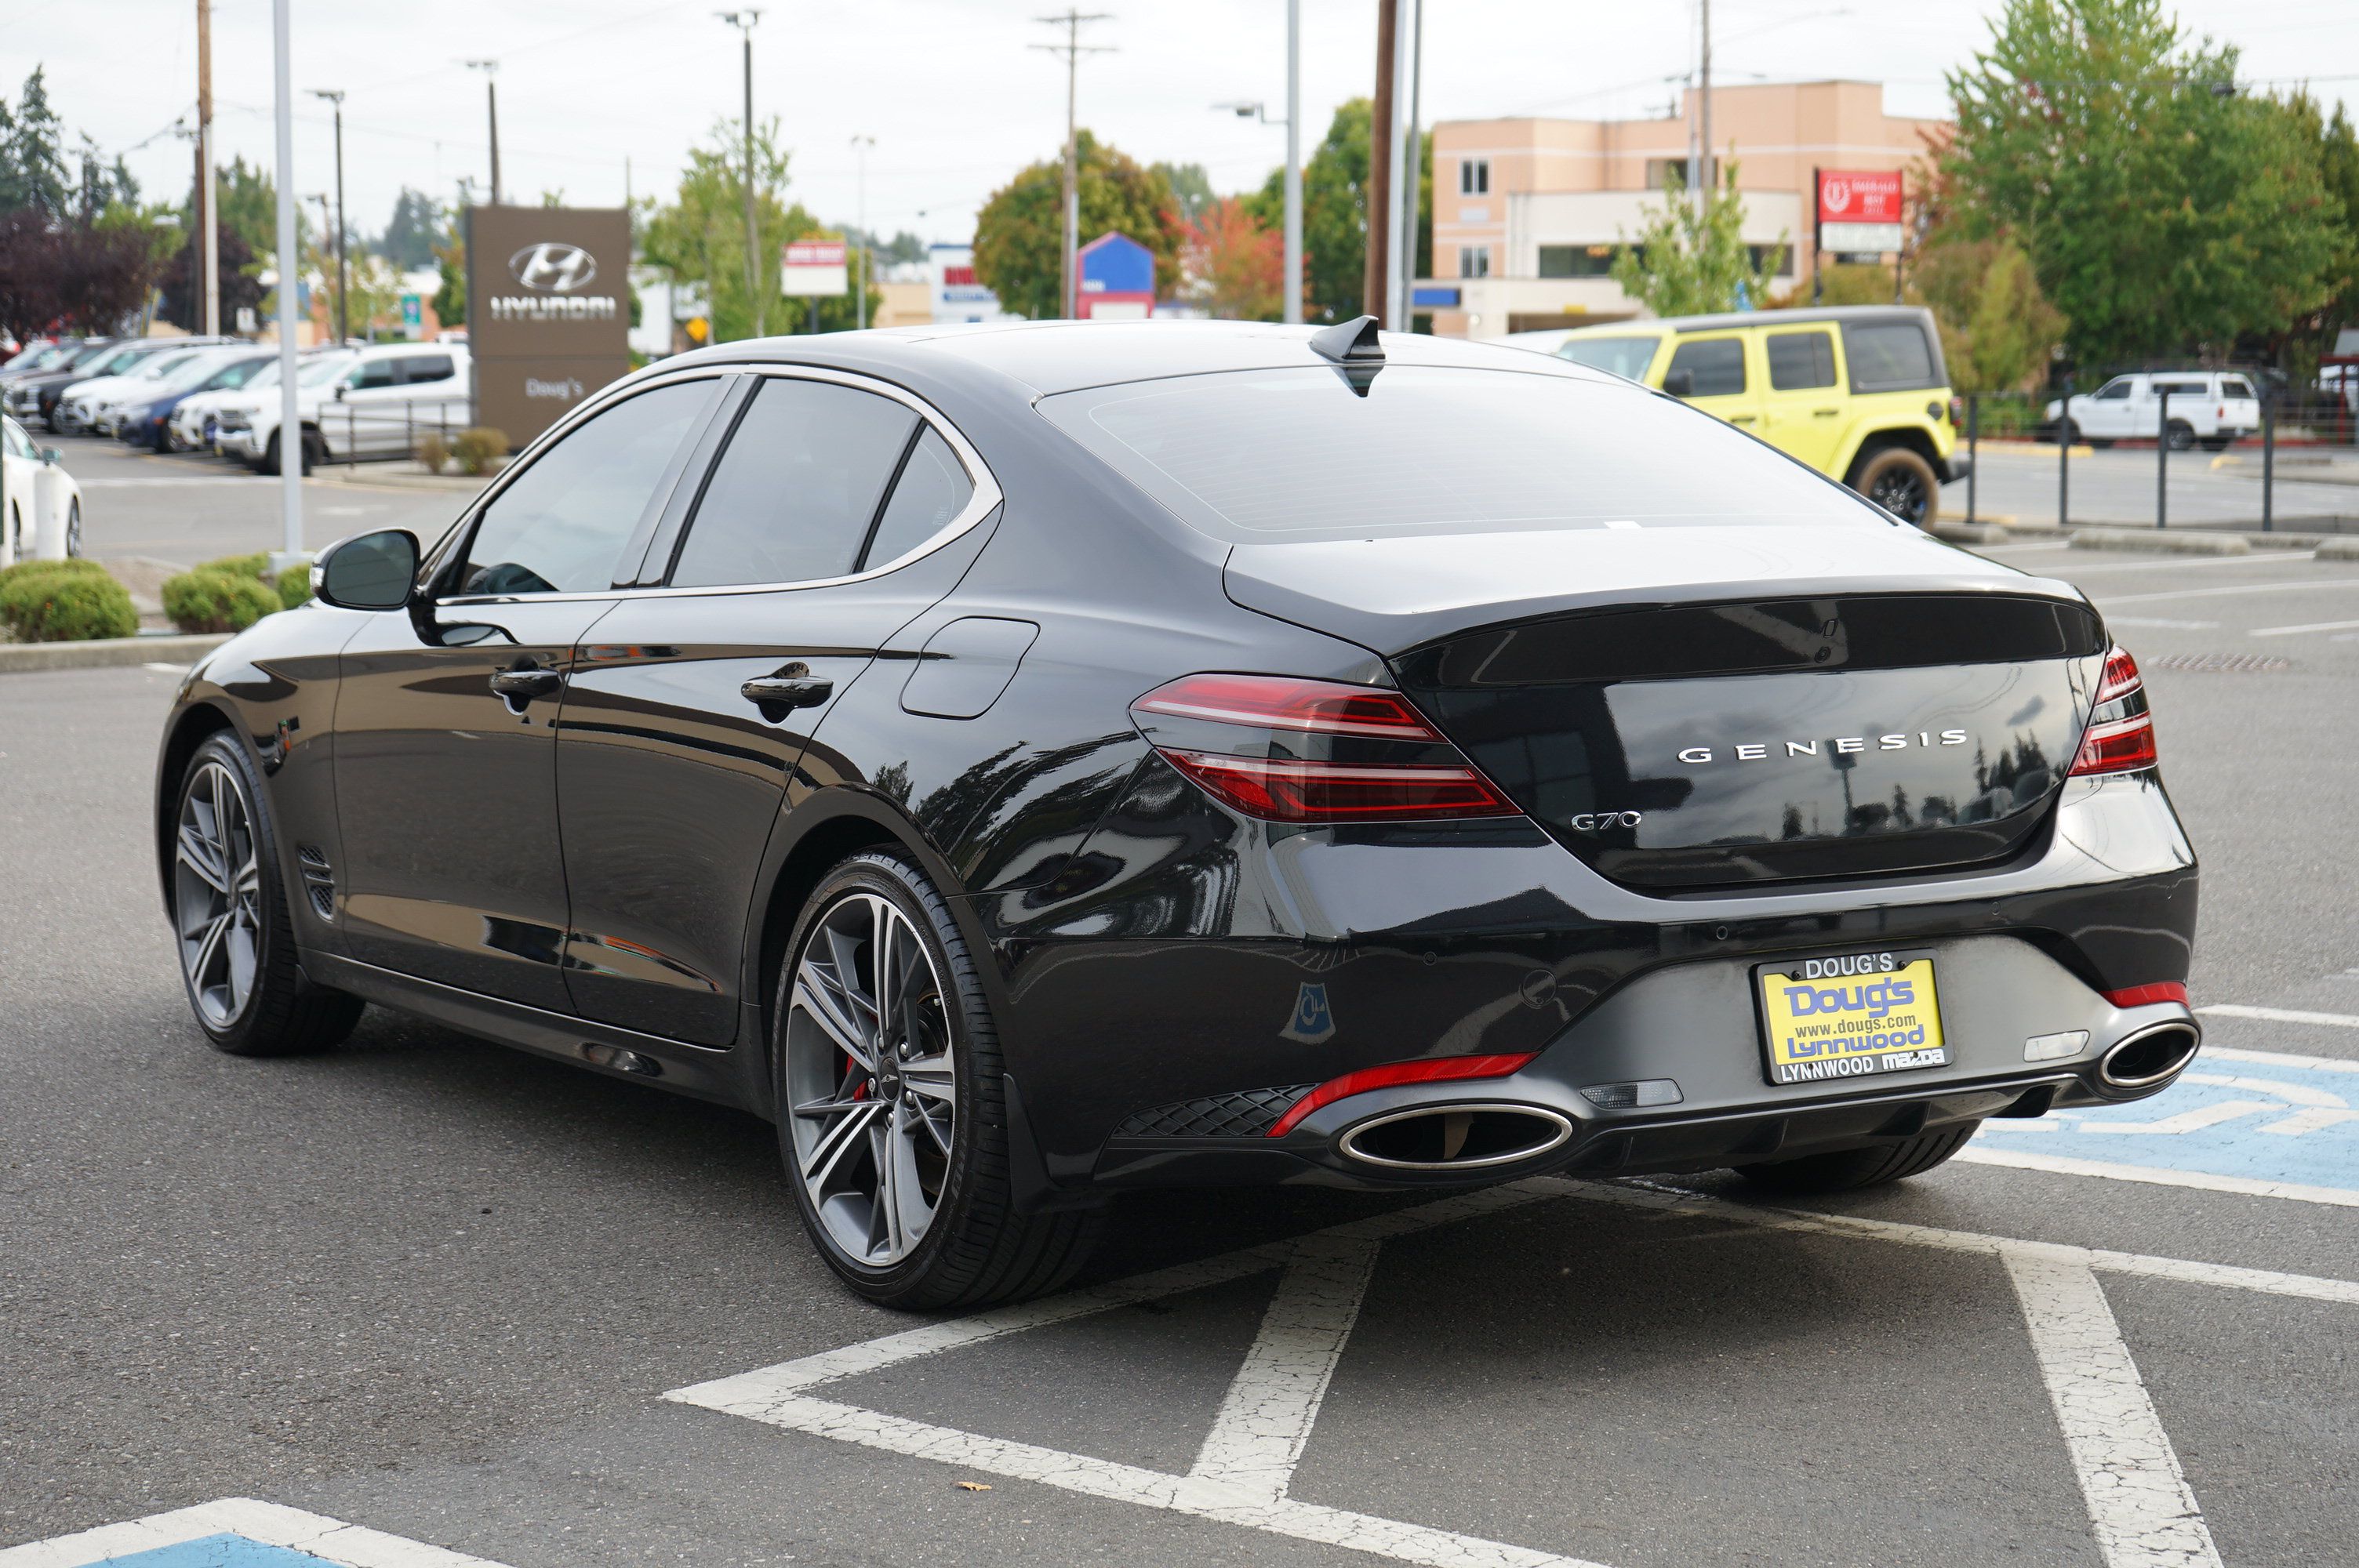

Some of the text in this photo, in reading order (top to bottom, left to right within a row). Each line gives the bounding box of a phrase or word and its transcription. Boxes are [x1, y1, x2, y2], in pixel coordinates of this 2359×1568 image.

[490, 296, 616, 320] HYUNDAI
[525, 377, 583, 400] Doug's
[1677, 729, 1968, 764] GENESIS
[1571, 810, 1642, 832] G70
[1805, 953, 1894, 980] DOUG'S
[1795, 1014, 1917, 1038] www.dougs.com
[1787, 1024, 1925, 1058] Lynnwood
[1780, 1056, 1874, 1083] LYNNWOOD
